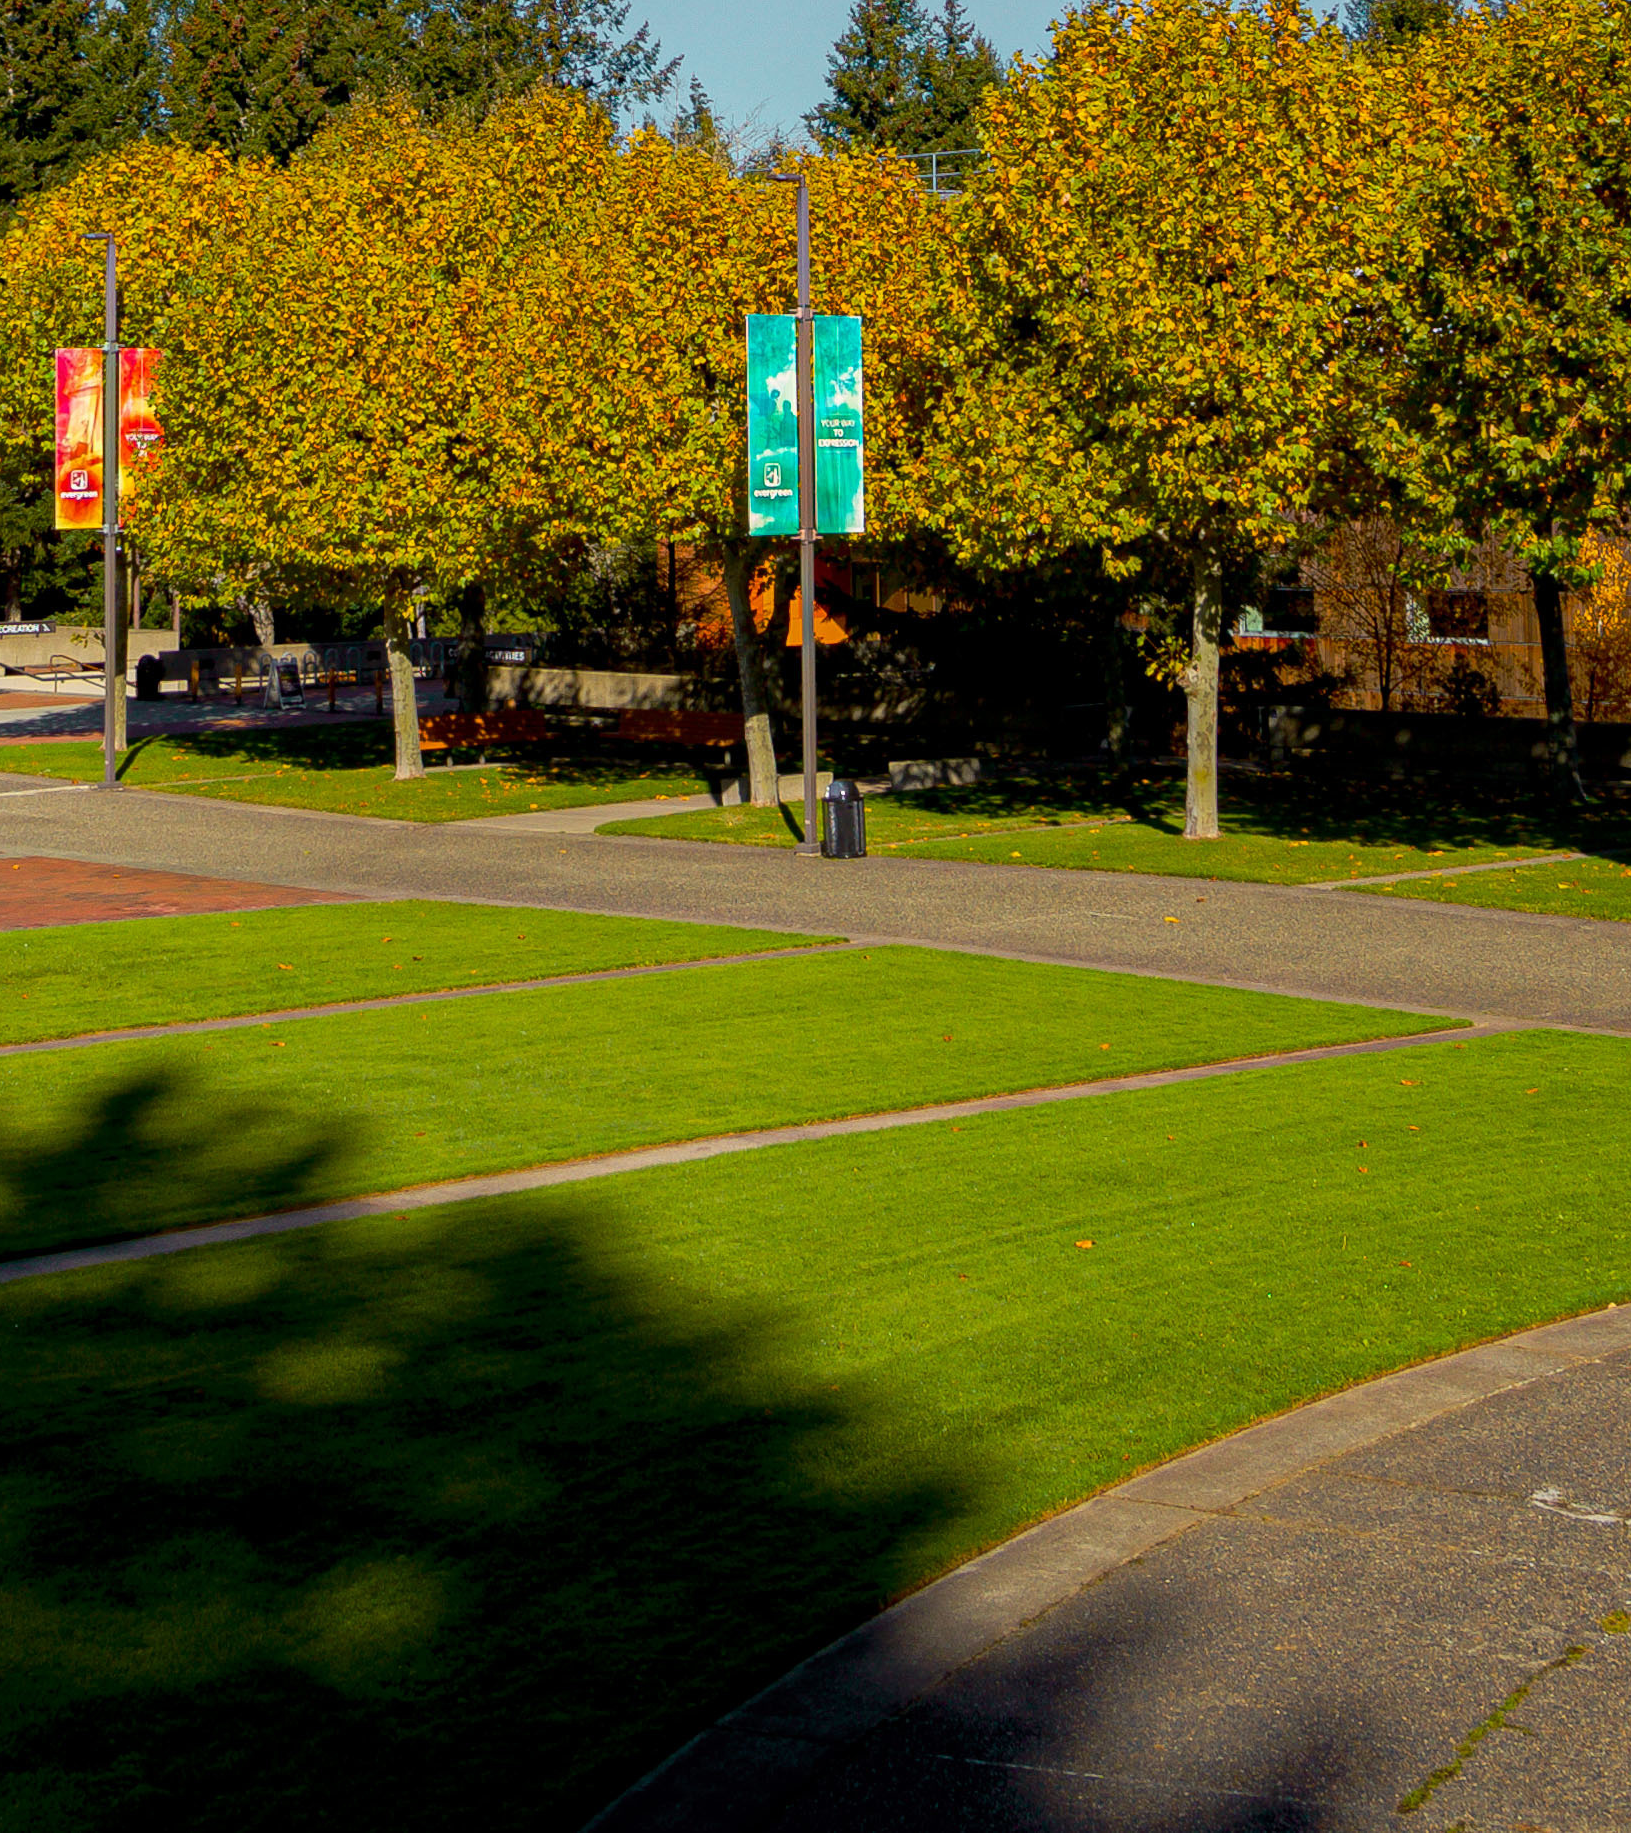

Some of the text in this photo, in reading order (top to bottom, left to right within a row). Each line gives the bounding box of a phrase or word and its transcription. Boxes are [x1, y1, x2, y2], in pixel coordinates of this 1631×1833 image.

[821, 419, 856, 427] YOUR WAY
[833, 429, 844, 437] TO
[818, 439, 860, 447] EXPRESSION
[60, 491, 98, 500] evergreen
[753, 489, 793, 500] evergreen
